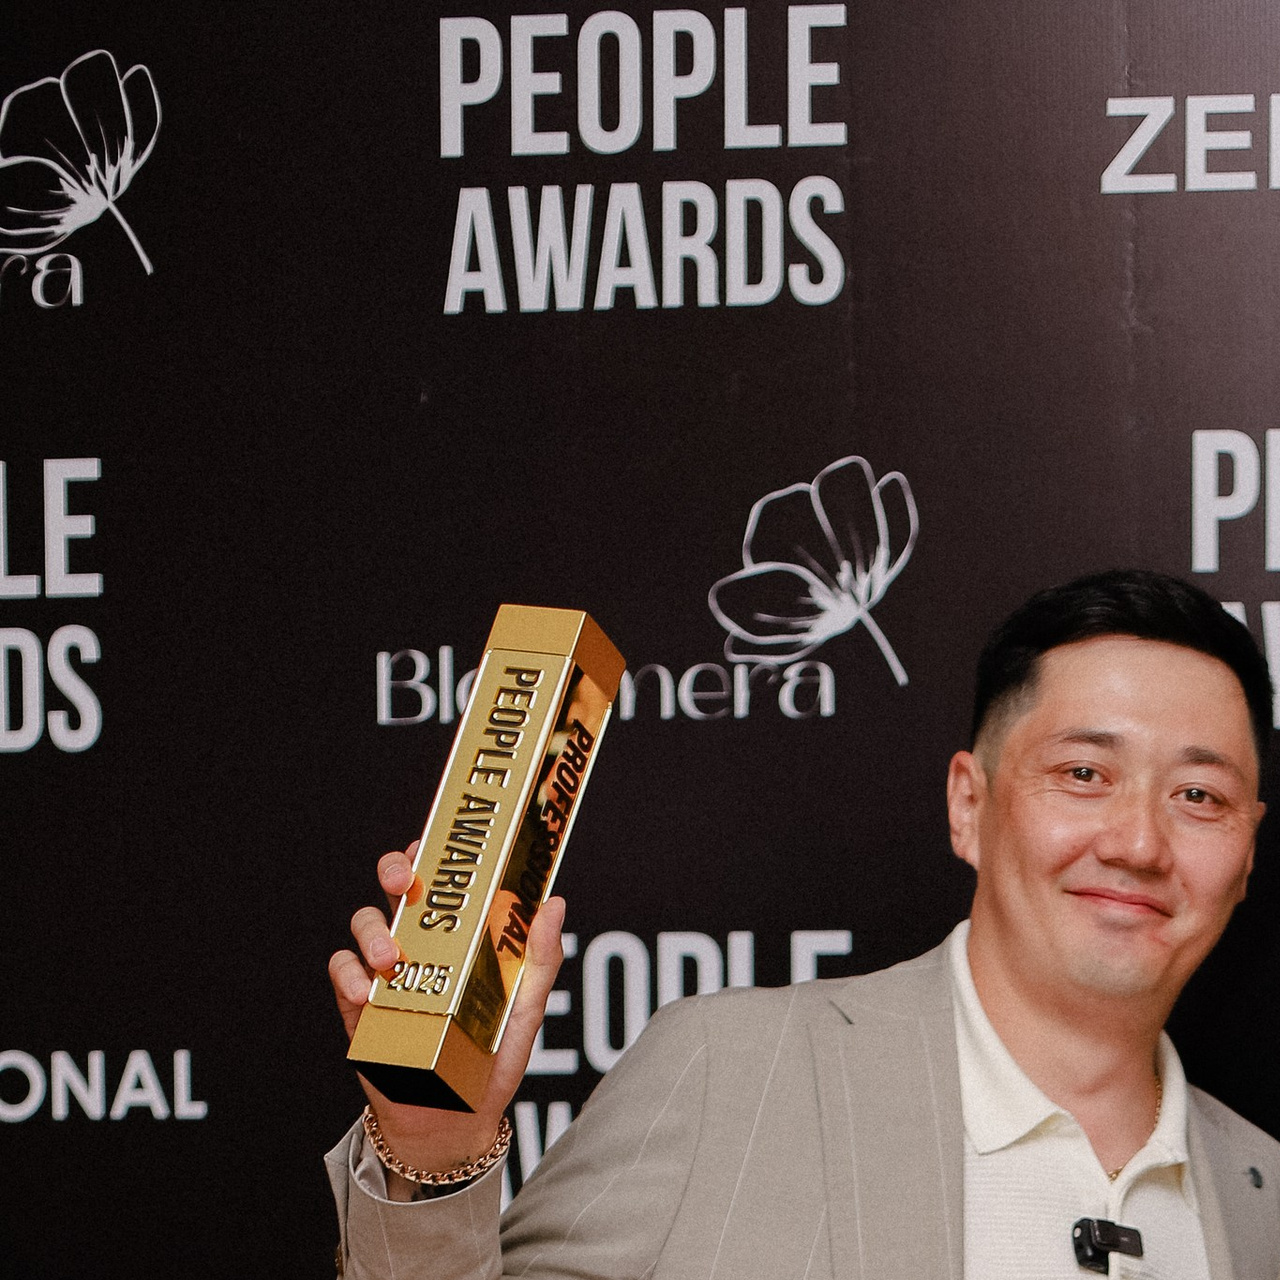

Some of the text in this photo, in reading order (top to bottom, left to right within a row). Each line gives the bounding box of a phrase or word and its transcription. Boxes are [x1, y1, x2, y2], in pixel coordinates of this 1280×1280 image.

[439, 4, 848, 158] PEOPLE
[443, 175, 846, 315] AWARDS
[420, 666, 544, 934] PEOPLE AWARDS
[390, 959, 454, 997] 2025
